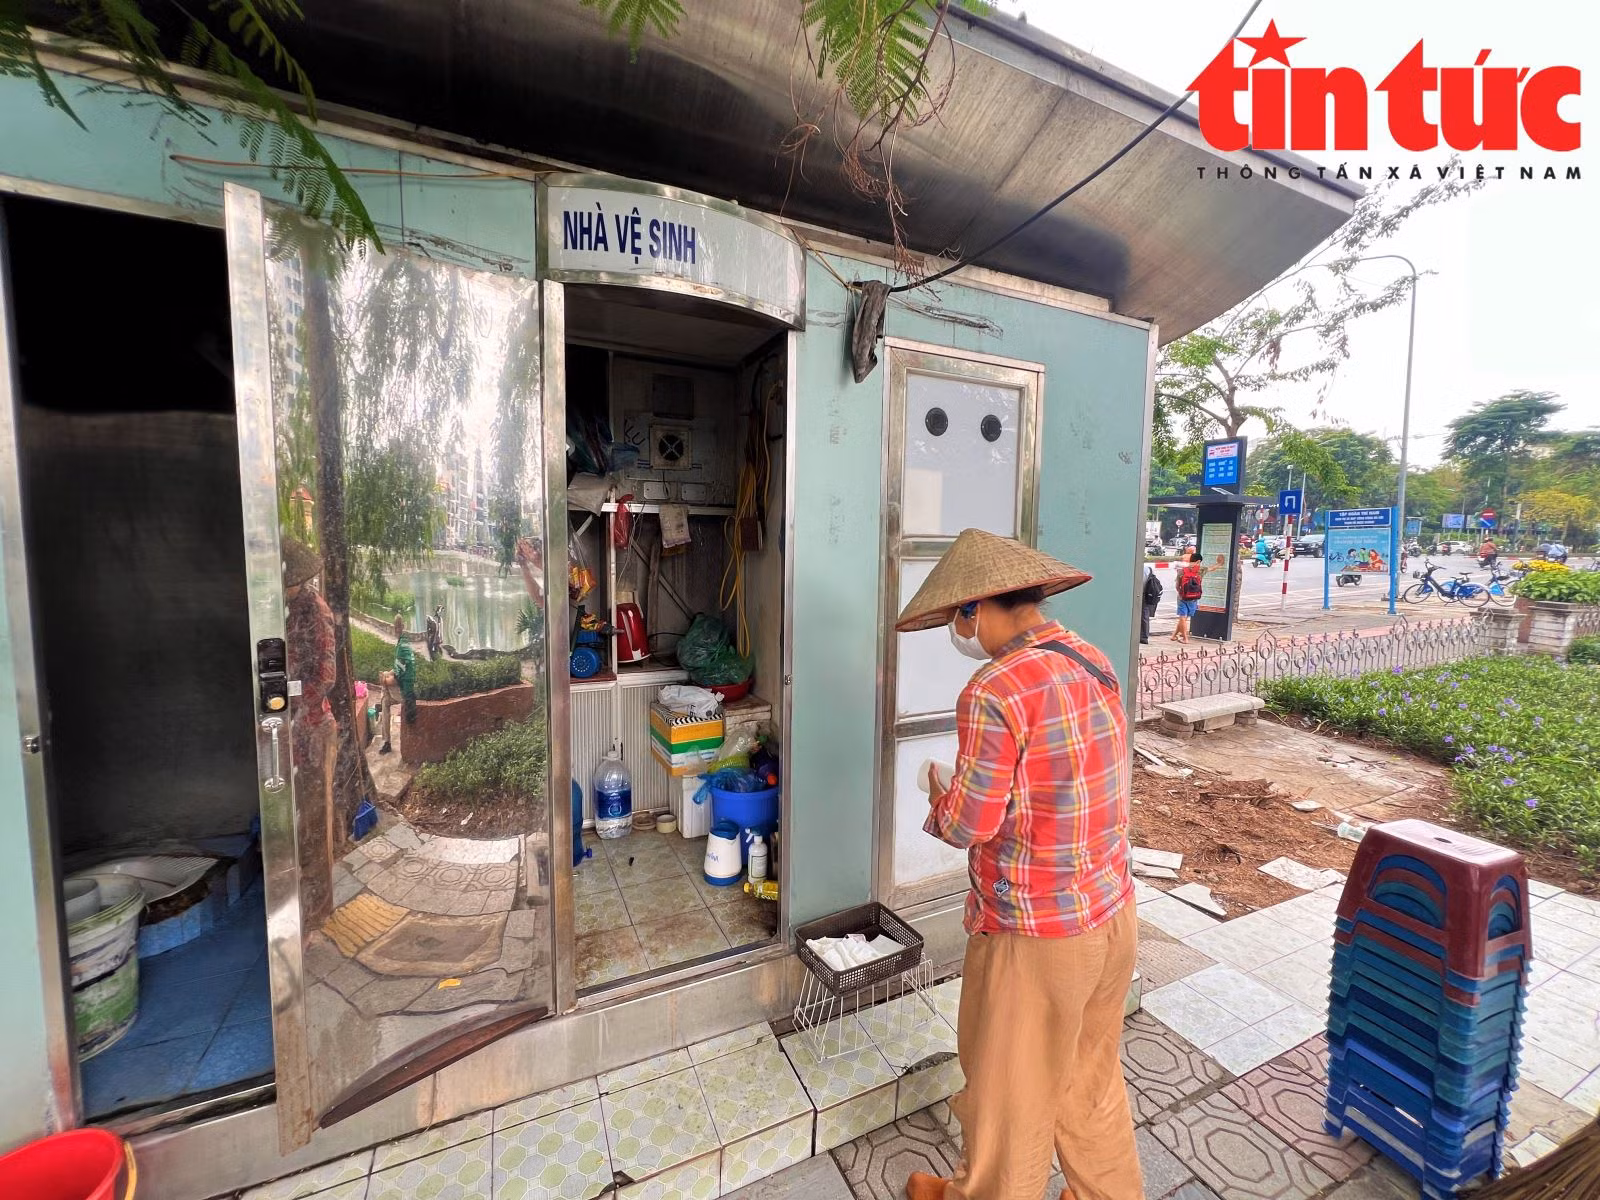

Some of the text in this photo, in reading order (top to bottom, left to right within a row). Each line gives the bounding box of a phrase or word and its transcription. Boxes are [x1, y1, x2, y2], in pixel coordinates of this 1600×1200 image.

[563, 201, 696, 264] NHÀ VỆ SINH
